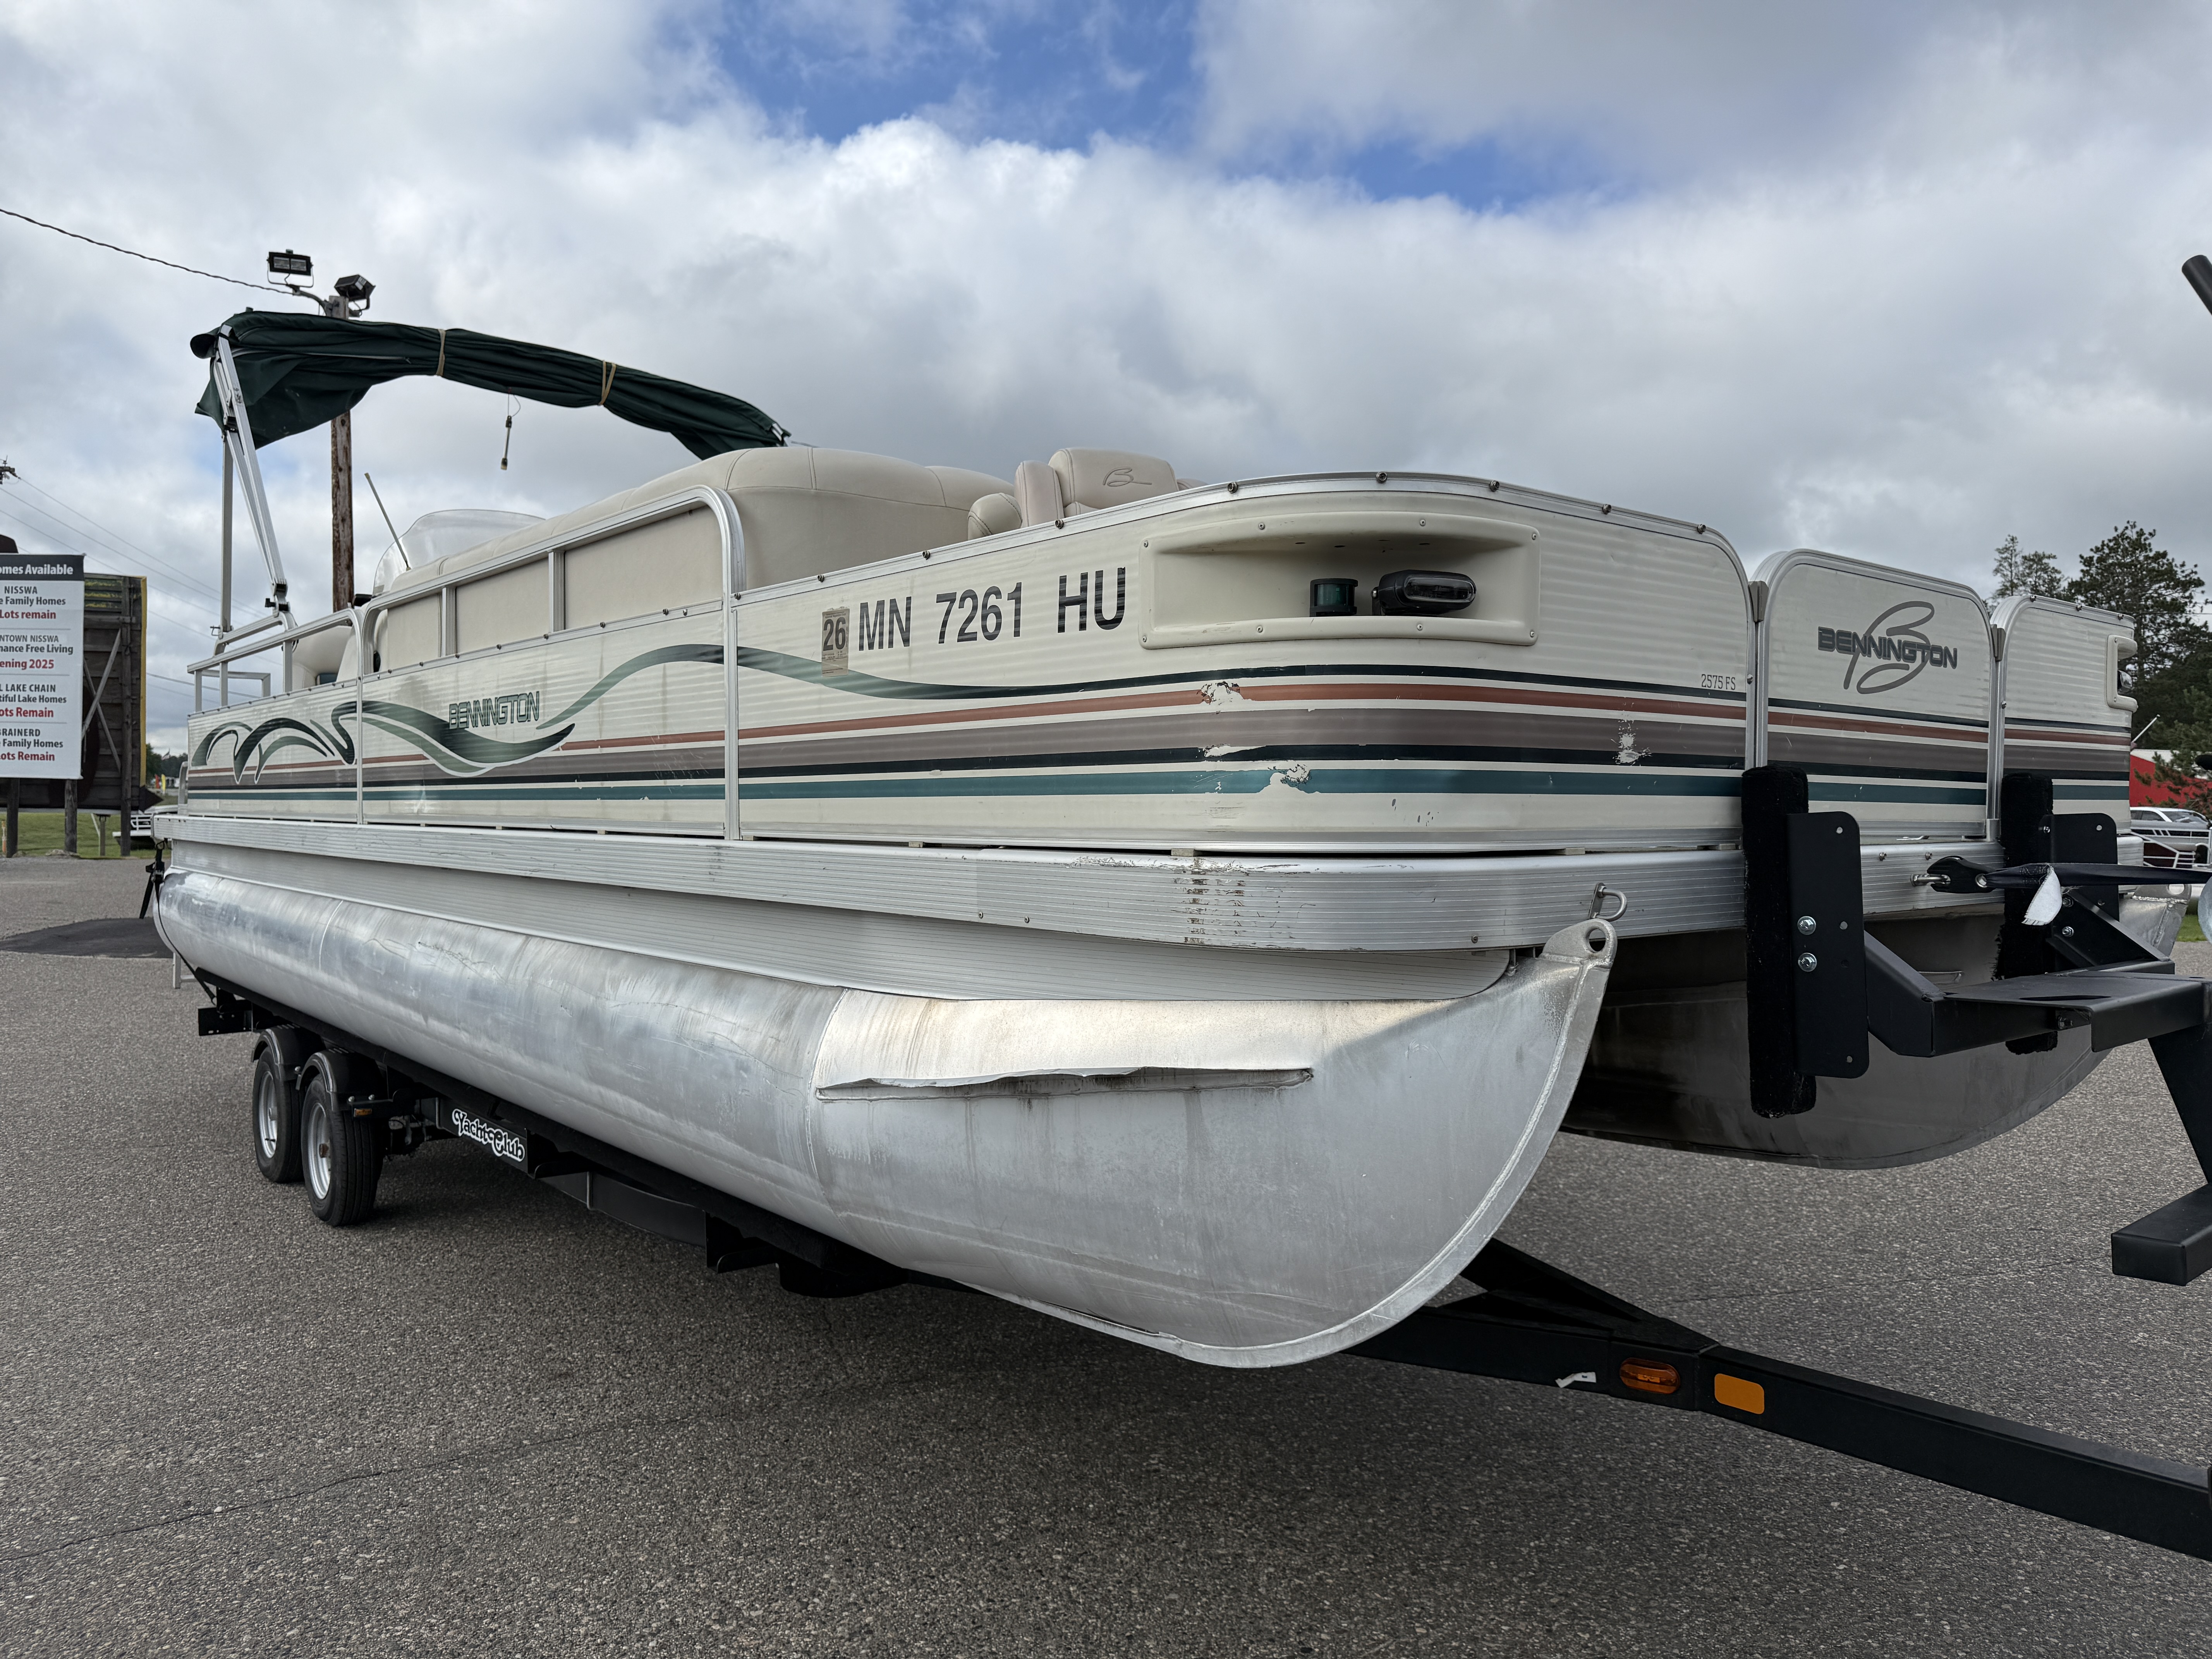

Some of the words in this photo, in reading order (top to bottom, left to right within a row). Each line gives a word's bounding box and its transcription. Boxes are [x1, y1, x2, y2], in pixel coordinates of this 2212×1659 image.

[25, 564, 73, 575] Available
[4, 586, 38, 594] NISSWA
[5, 596, 34, 607] Family
[36, 597, 66, 605] Homes
[21, 610, 56, 619] remain
[859, 596, 912, 651] MN
[936, 582, 1022, 644] 7261
[1058, 567, 1126, 633] HU
[823, 617, 846, 651] 26
[26, 644, 45, 653] Free
[47, 644, 73, 655] Living
[1817, 626, 1958, 669] BENNINGTON
[29, 659, 54, 669] 2025
[1701, 674, 1723, 689] 2575
[1726, 677, 1736, 690] FS
[6, 684, 27, 692] LAKE
[29, 684, 56, 692] CHAIN
[18, 694, 37, 702] Lake
[39, 695, 67, 703] Homes
[16, 707, 54, 718] Remain
[449, 691, 539, 729] BENNINGTON
[0, 728, 40, 737] RAINERD
[3, 738, 31, 749] Family
[34, 739, 63, 748] Homes
[0, 752, 15, 760] ots
[18, 751, 55, 761] Remain
